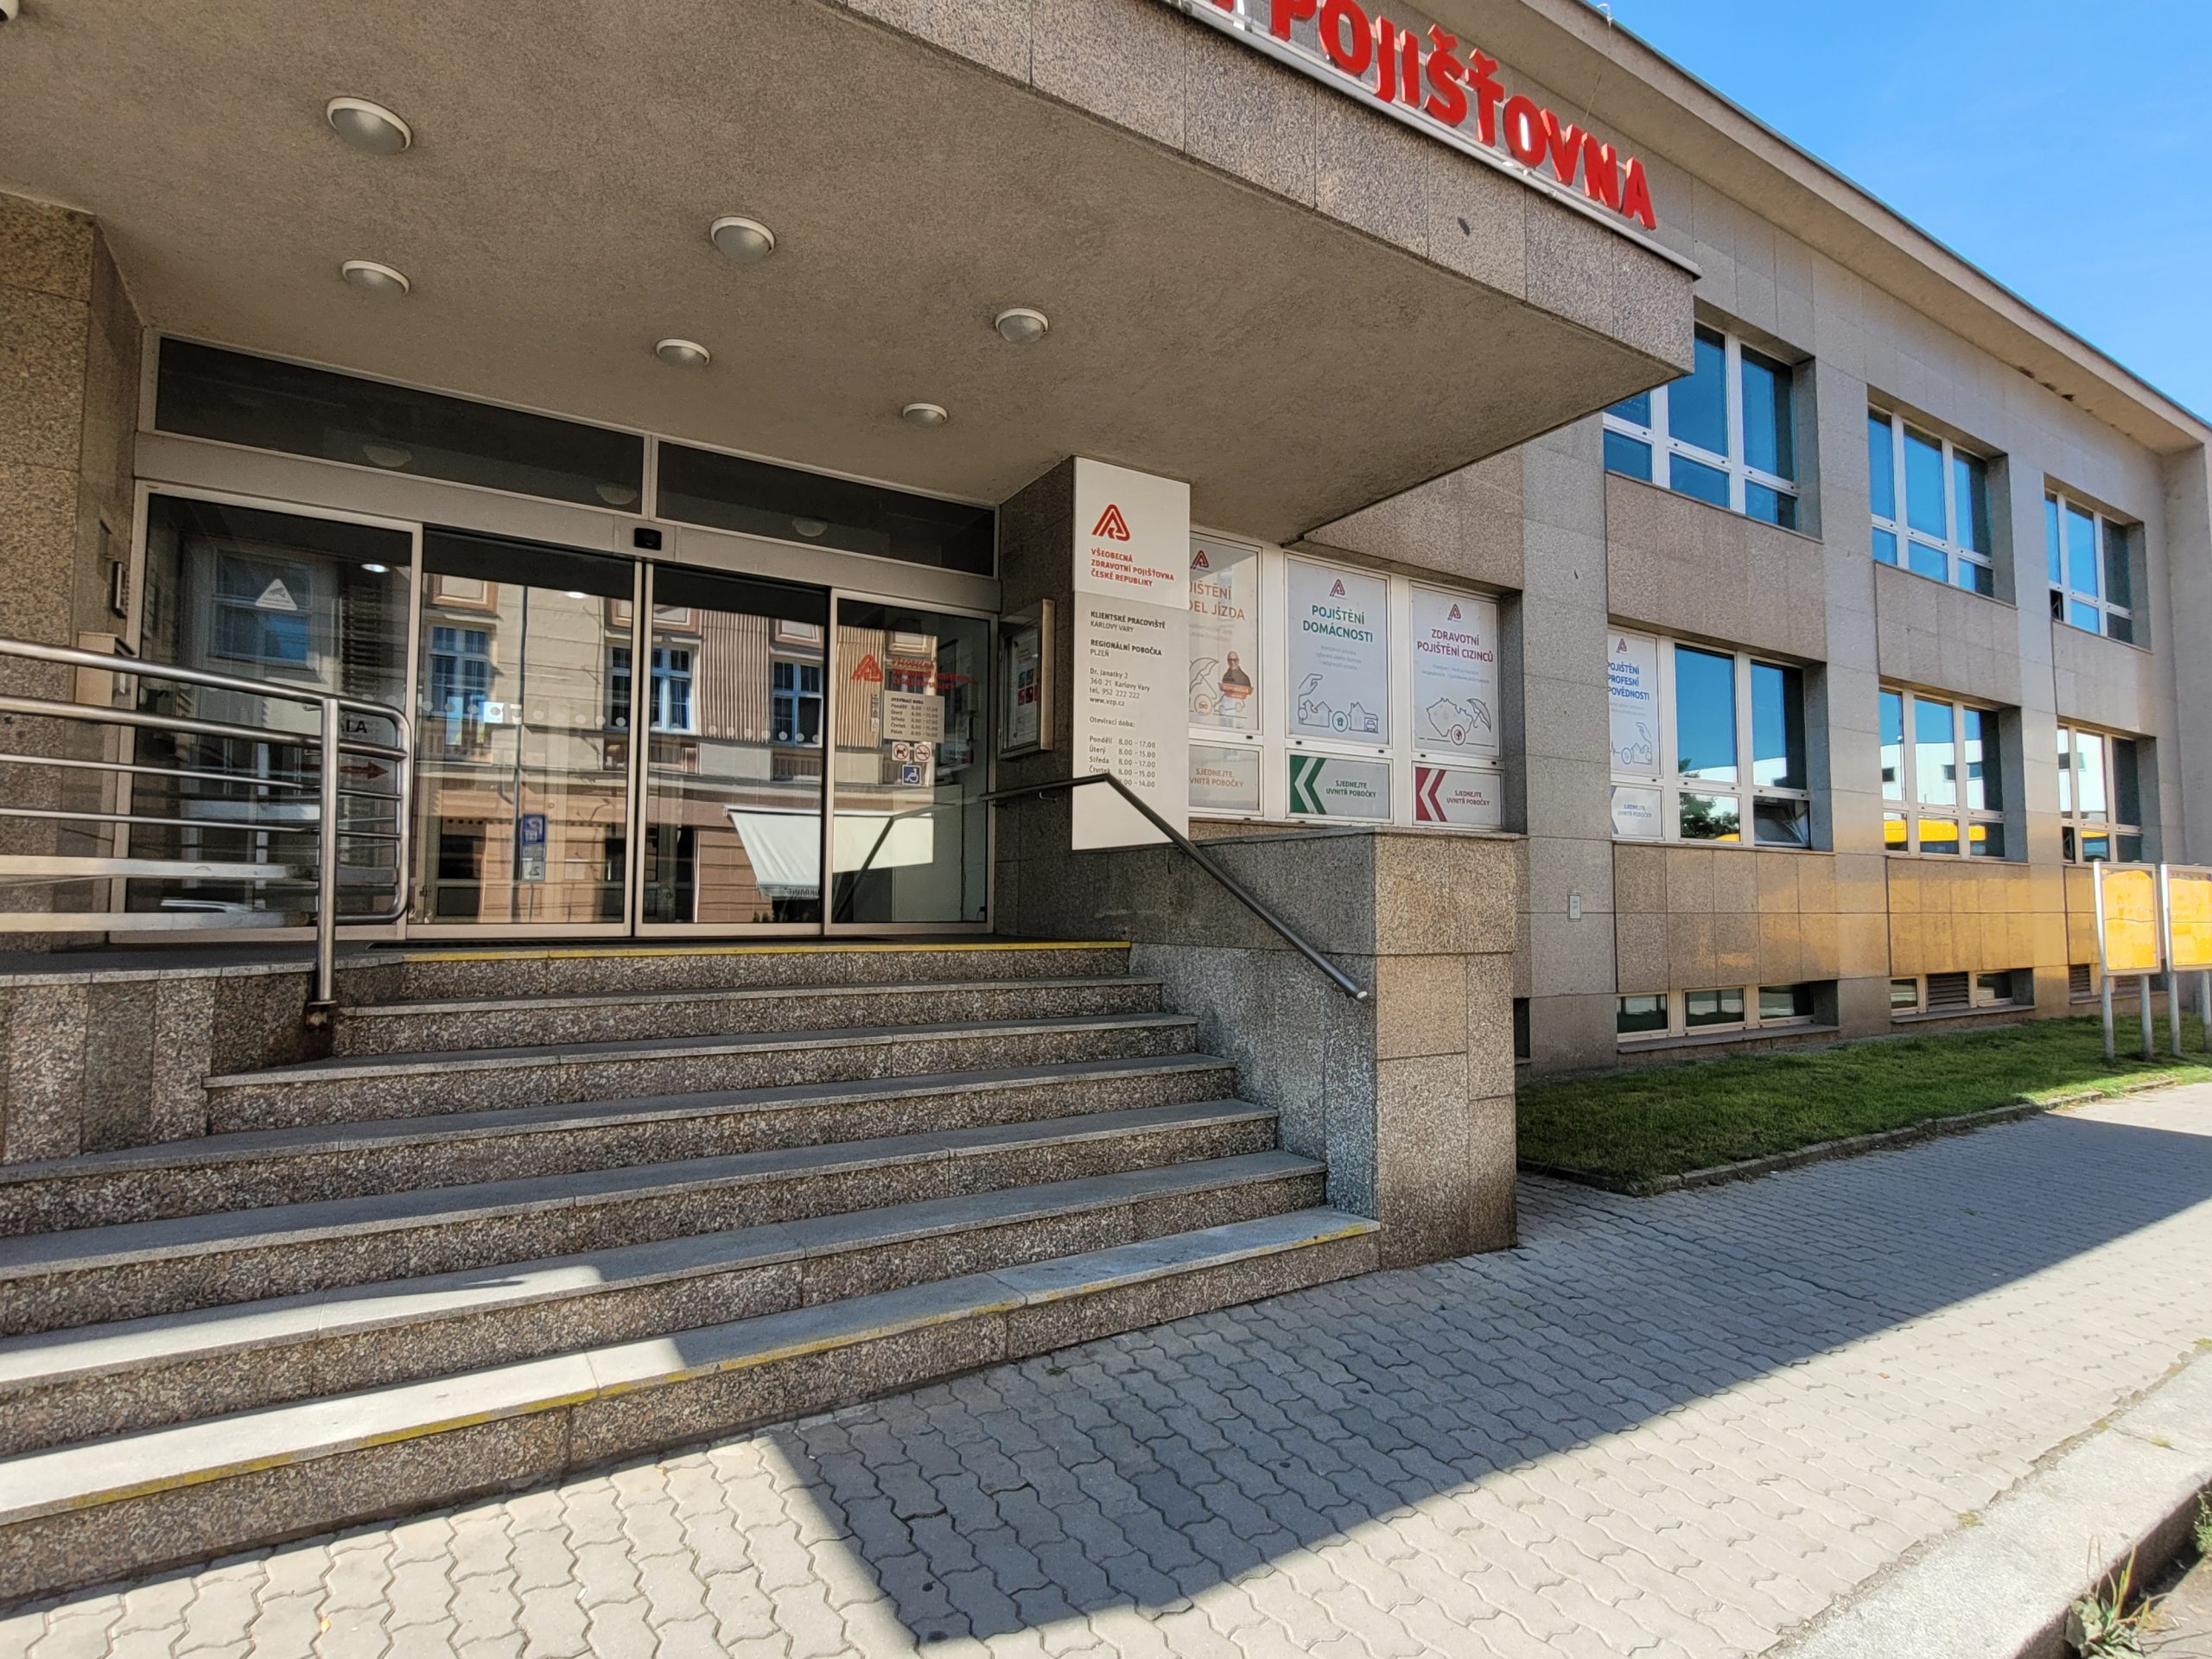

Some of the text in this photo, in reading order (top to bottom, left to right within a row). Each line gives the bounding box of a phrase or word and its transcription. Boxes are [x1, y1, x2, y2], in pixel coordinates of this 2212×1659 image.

[1270, 0, 1657, 231] POJIŠŤOVNA
[1090, 548, 1134, 563] VŠEOBECNÁ
[1090, 559, 1174, 581] ZDRAVOTNÍ POJIŠŤOVNA
[1090, 569, 1153, 587] ČESKÉ REPUBLIKY
[1211, 601, 1245, 620] JÍZDA
[1312, 605, 1365, 625] POJIŠTĚNÍ
[1090, 611, 1166, 629] KLIENTSKÉ PRACOVIŠTĚ
[1090, 620, 1134, 632] KARLOVY VARY
[1303, 620, 1373, 643] DOMÁCNOSTI
[1431, 628, 1479, 646] ZDRAVOTNÍ
[1090, 639, 1162, 656] REGIONÁLNÍ POBOČKA
[1417, 640, 1493, 663] POJIŠTĚNÍ CIZINCŮ
[1090, 667, 1099, 676] Dr.
[1114, 681, 1136, 690] Karlovy
[1089, 697, 1125, 707] www.vzp.cz
[1089, 716, 1135, 727] Otevírací doba:
[1089, 735, 1113, 744] Pondělí
[1118, 738, 1133, 747] 8.00
[1089, 744, 1106, 754] Úterý
[1195, 767, 1233, 778] SJEDNEJTE
[1189, 777, 1244, 788] VNITŘ POBOČKY
[1335, 779, 1368, 789] SJEDNEJTE
[1325, 787, 1376, 798] UVNITŘ POBOČKY
